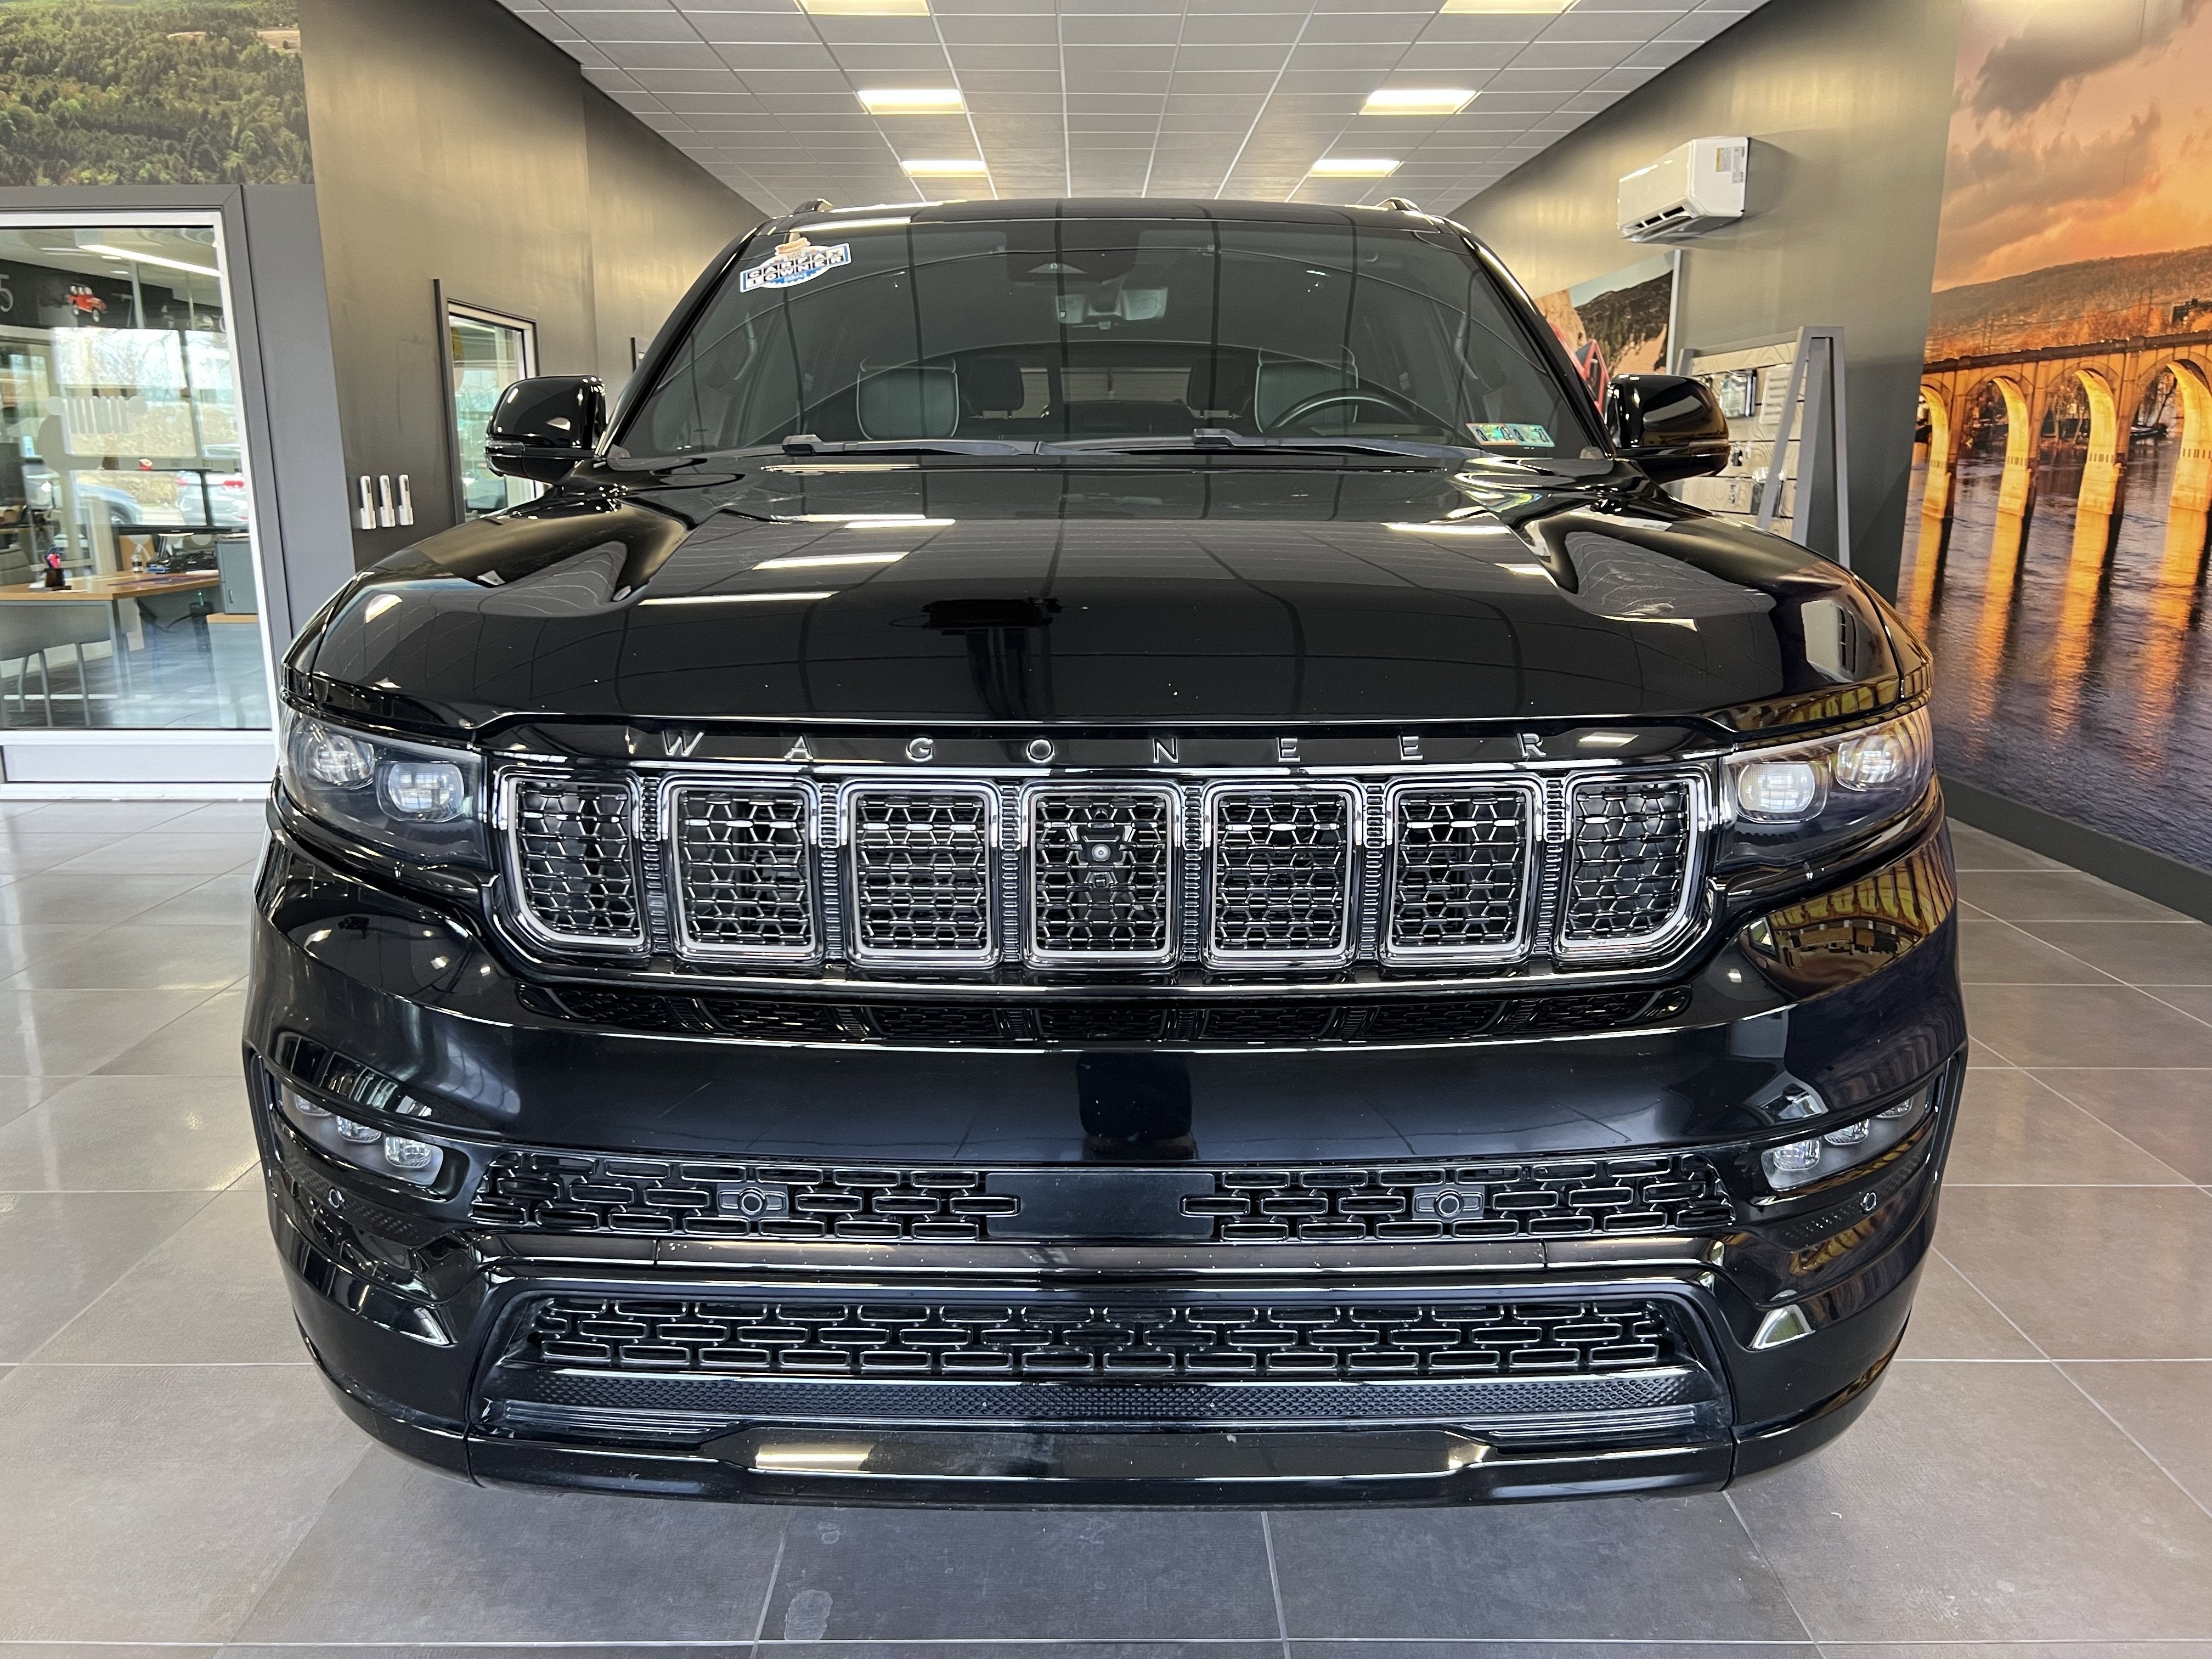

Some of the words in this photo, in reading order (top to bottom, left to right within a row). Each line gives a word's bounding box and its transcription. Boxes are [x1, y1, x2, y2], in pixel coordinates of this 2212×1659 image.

[748, 250, 840, 279] CARFAX
[764, 256, 842, 281] OWNER
[661, 730, 1547, 763] WAGONEER
